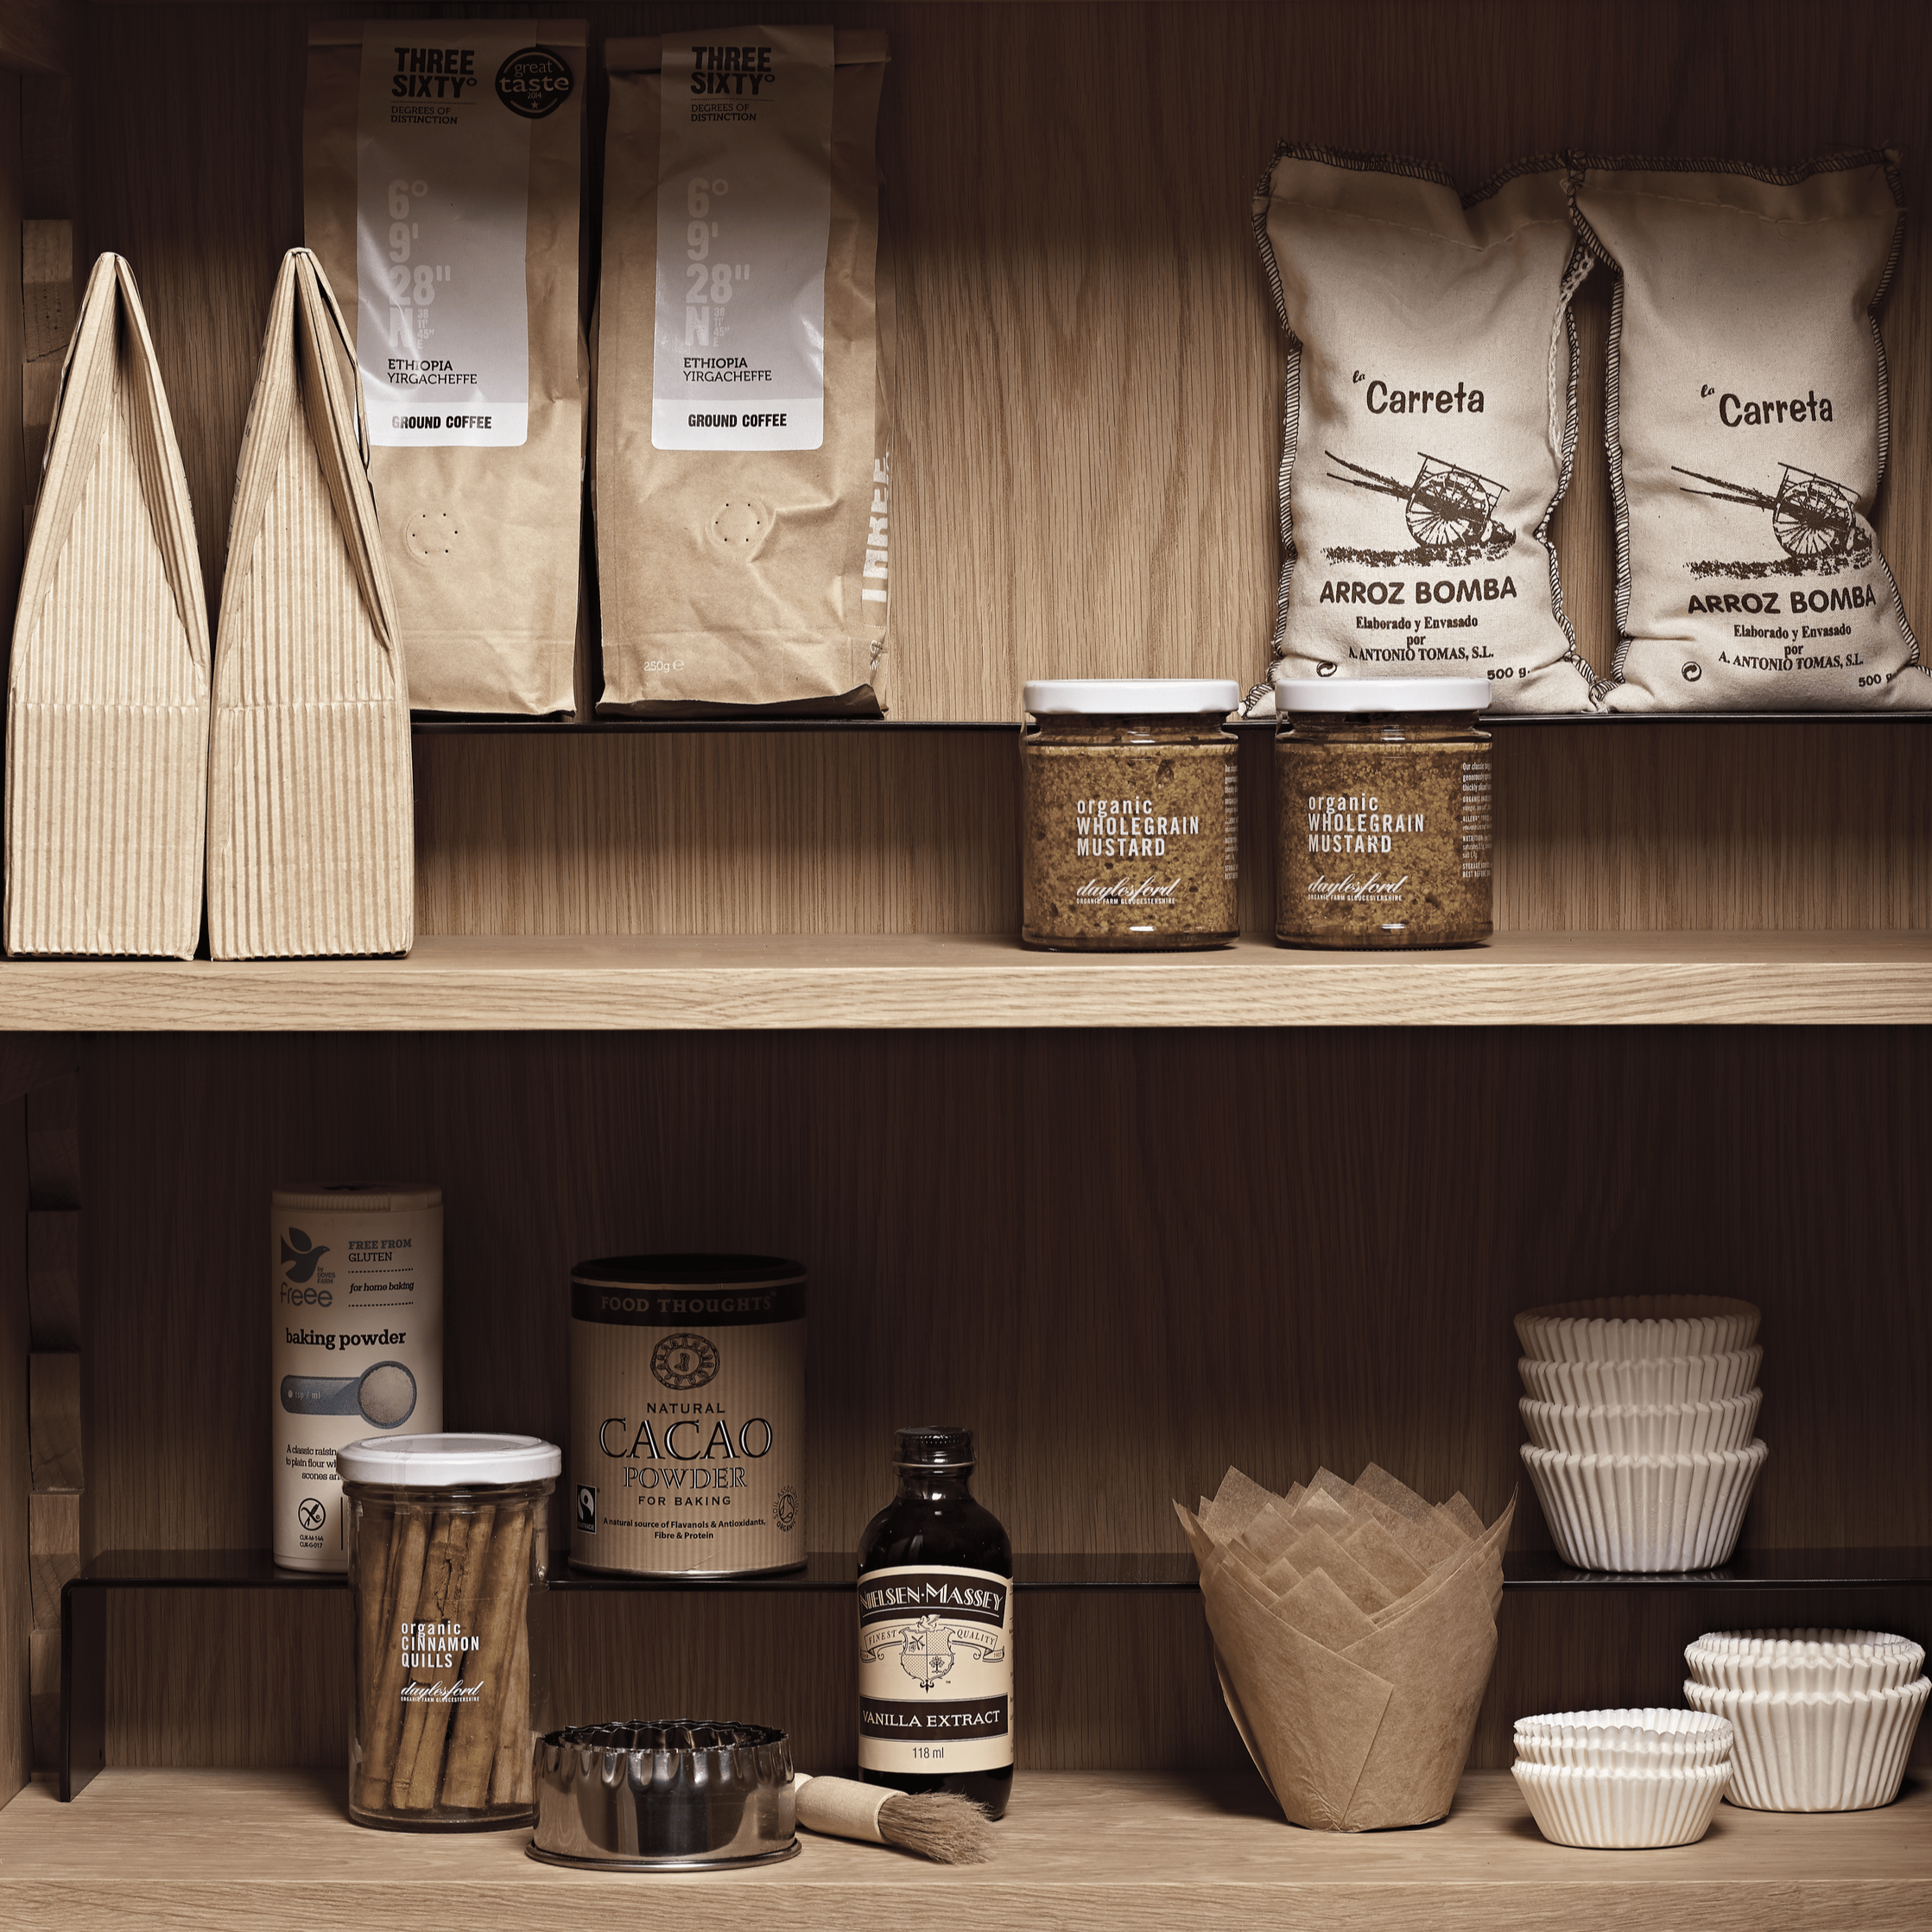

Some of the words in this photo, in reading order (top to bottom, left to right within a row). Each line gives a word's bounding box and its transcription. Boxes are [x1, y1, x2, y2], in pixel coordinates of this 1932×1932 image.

[394, 48, 475, 75] THREE
[692, 46, 771, 73] THREE
[514, 60, 553, 78] great
[498, 75, 569, 92] taste
[391, 106, 434, 115] DEGREES
[691, 104, 733, 112] DEGREES
[390, 115, 458, 124] DISTINCTION
[690, 112, 757, 122] DISTINCTION
[388, 358, 453, 371] ETHIOPIA
[683, 358, 748, 369] ETHIOPIA
[387, 372, 478, 384] YIRGACHEFFE
[683, 371, 772, 382] YIRGACHEFFE
[1352, 370, 1365, 384] la
[1366, 380, 1485, 415] Carreta
[1701, 384, 1715, 398] la
[1719, 390, 1834, 428] Carreta
[392, 416, 441, 429] GROUND
[446, 415, 492, 429] COFFEE
[688, 414, 738, 428] GROUND
[742, 414, 787, 427] COFFEE
[1320, 580, 1405, 605] ARROZ
[1416, 576, 1517, 605] BOMBA
[1688, 592, 1781, 614] ARROZ
[1790, 584, 1877, 613] BOMBA
[1356, 616, 1412, 630] Elaborado
[1415, 620, 1422, 632] y
[1423, 615, 1479, 629] Envasado
[1733, 624, 1789, 639] Elaborado
[1791, 629, 1799, 641] y
[1802, 624, 1852, 638] Envasado
[1406, 634, 1426, 649] por
[1359, 647, 1416, 662] ANTONIO
[1418, 648, 1469, 662] TOMAS,
[1472, 645, 1494, 659] S.L.
[1784, 643, 1803, 658] por
[643, 661, 671, 673] 250g
[1719, 650, 1730, 663] A.
[1733, 655, 1793, 671] ANTONIO
[1796, 655, 1843, 669] TOMAS,
[1845, 653, 1864, 667] S.L.
[1487, 667, 1514, 680] 500
[1859, 674, 1881, 687] 500
[1077, 795, 1152, 818] organic
[1308, 793, 1378, 814] organic
[1077, 816, 1199, 835] WHOLEGRAIN
[1308, 813, 1424, 833] WHOLEGRAIN
[1077, 838, 1165, 857] MUSTARD
[1308, 834, 1391, 853] MUSTARD
[1076, 876, 1181, 902] daylesford
[1308, 872, 1409, 899] daylesford
[348, 1240, 378, 1250] FREE
[381, 1238, 412, 1249] FROM
[348, 1252, 392, 1263] GLUTEN
[280, 1282, 333, 1308] freee
[349, 1283, 362, 1294] for
[389, 1282, 415, 1291] baking
[601, 1295, 649, 1313] FOOD
[286, 1327, 335, 1350] baking
[339, 1328, 406, 1350] powder
[647, 1403, 725, 1414] NATURAL
[599, 1417, 773, 1460] CACAO
[286, 1444, 291, 1454] A
[292, 1445, 314, 1454] classic
[315, 1447, 337, 1456] raisin
[286, 1457, 291, 1466] to
[291, 1457, 307, 1468] plain
[308, 1459, 325, 1468] flour
[623, 1466, 747, 1489] POWDER
[638, 1496, 666, 1505] FOR
[675, 1496, 732, 1506] BAKING
[604, 1517, 608, 1525] A
[609, 1518, 633, 1527] natural
[634, 1520, 659, 1529] source
[719, 1517, 766, 1529] Antioxidants,
[401, 1620, 461, 1637] organic
[868, 1630, 897, 1646] FINEST
[957, 1628, 996, 1646] QUALITY
[402, 1636, 479, 1651] CINNAMON
[402, 1652, 453, 1669] QUILLS
[401, 1679, 484, 1701] daylesford
[862, 1710, 922, 1727] VANILLA
[927, 1710, 1000, 1727] EXTRACT
[912, 1747, 930, 1759] 118
[933, 1746, 944, 1758] ml
